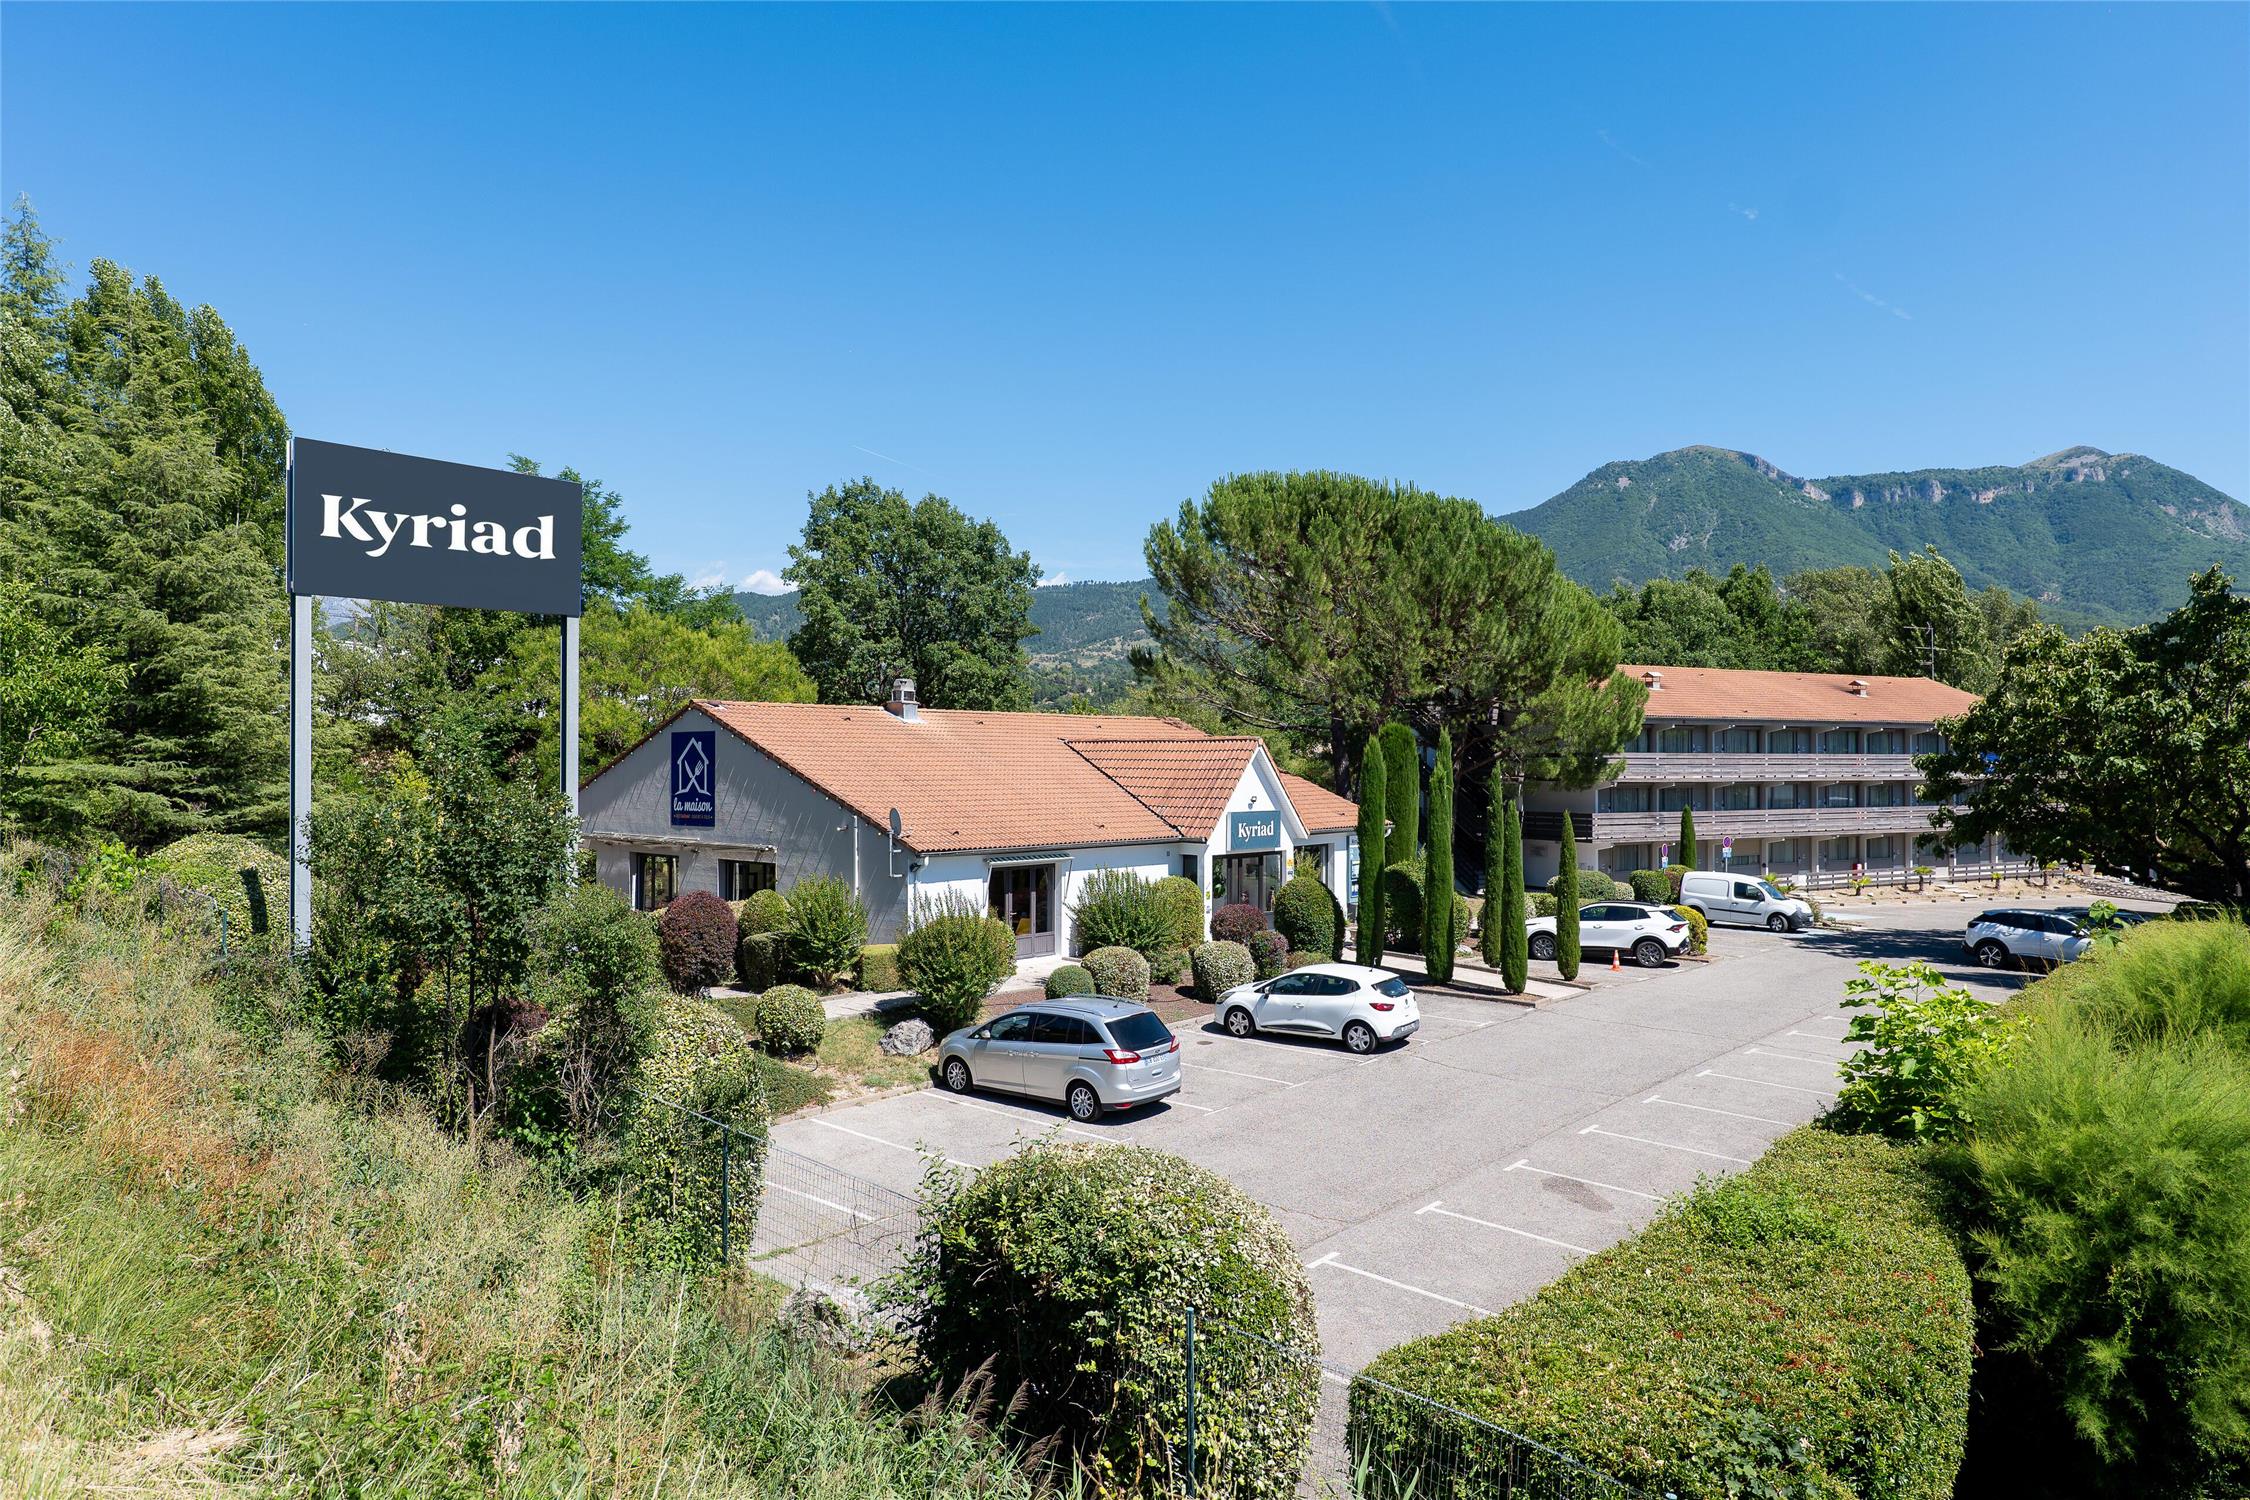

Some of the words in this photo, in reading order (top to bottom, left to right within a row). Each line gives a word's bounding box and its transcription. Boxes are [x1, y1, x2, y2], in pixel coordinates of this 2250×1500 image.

[320, 494, 556, 559] Kyriad
[673, 797, 683, 812] la
[684, 797, 713, 812] maison
[1238, 820, 1274, 842] Kyriad
